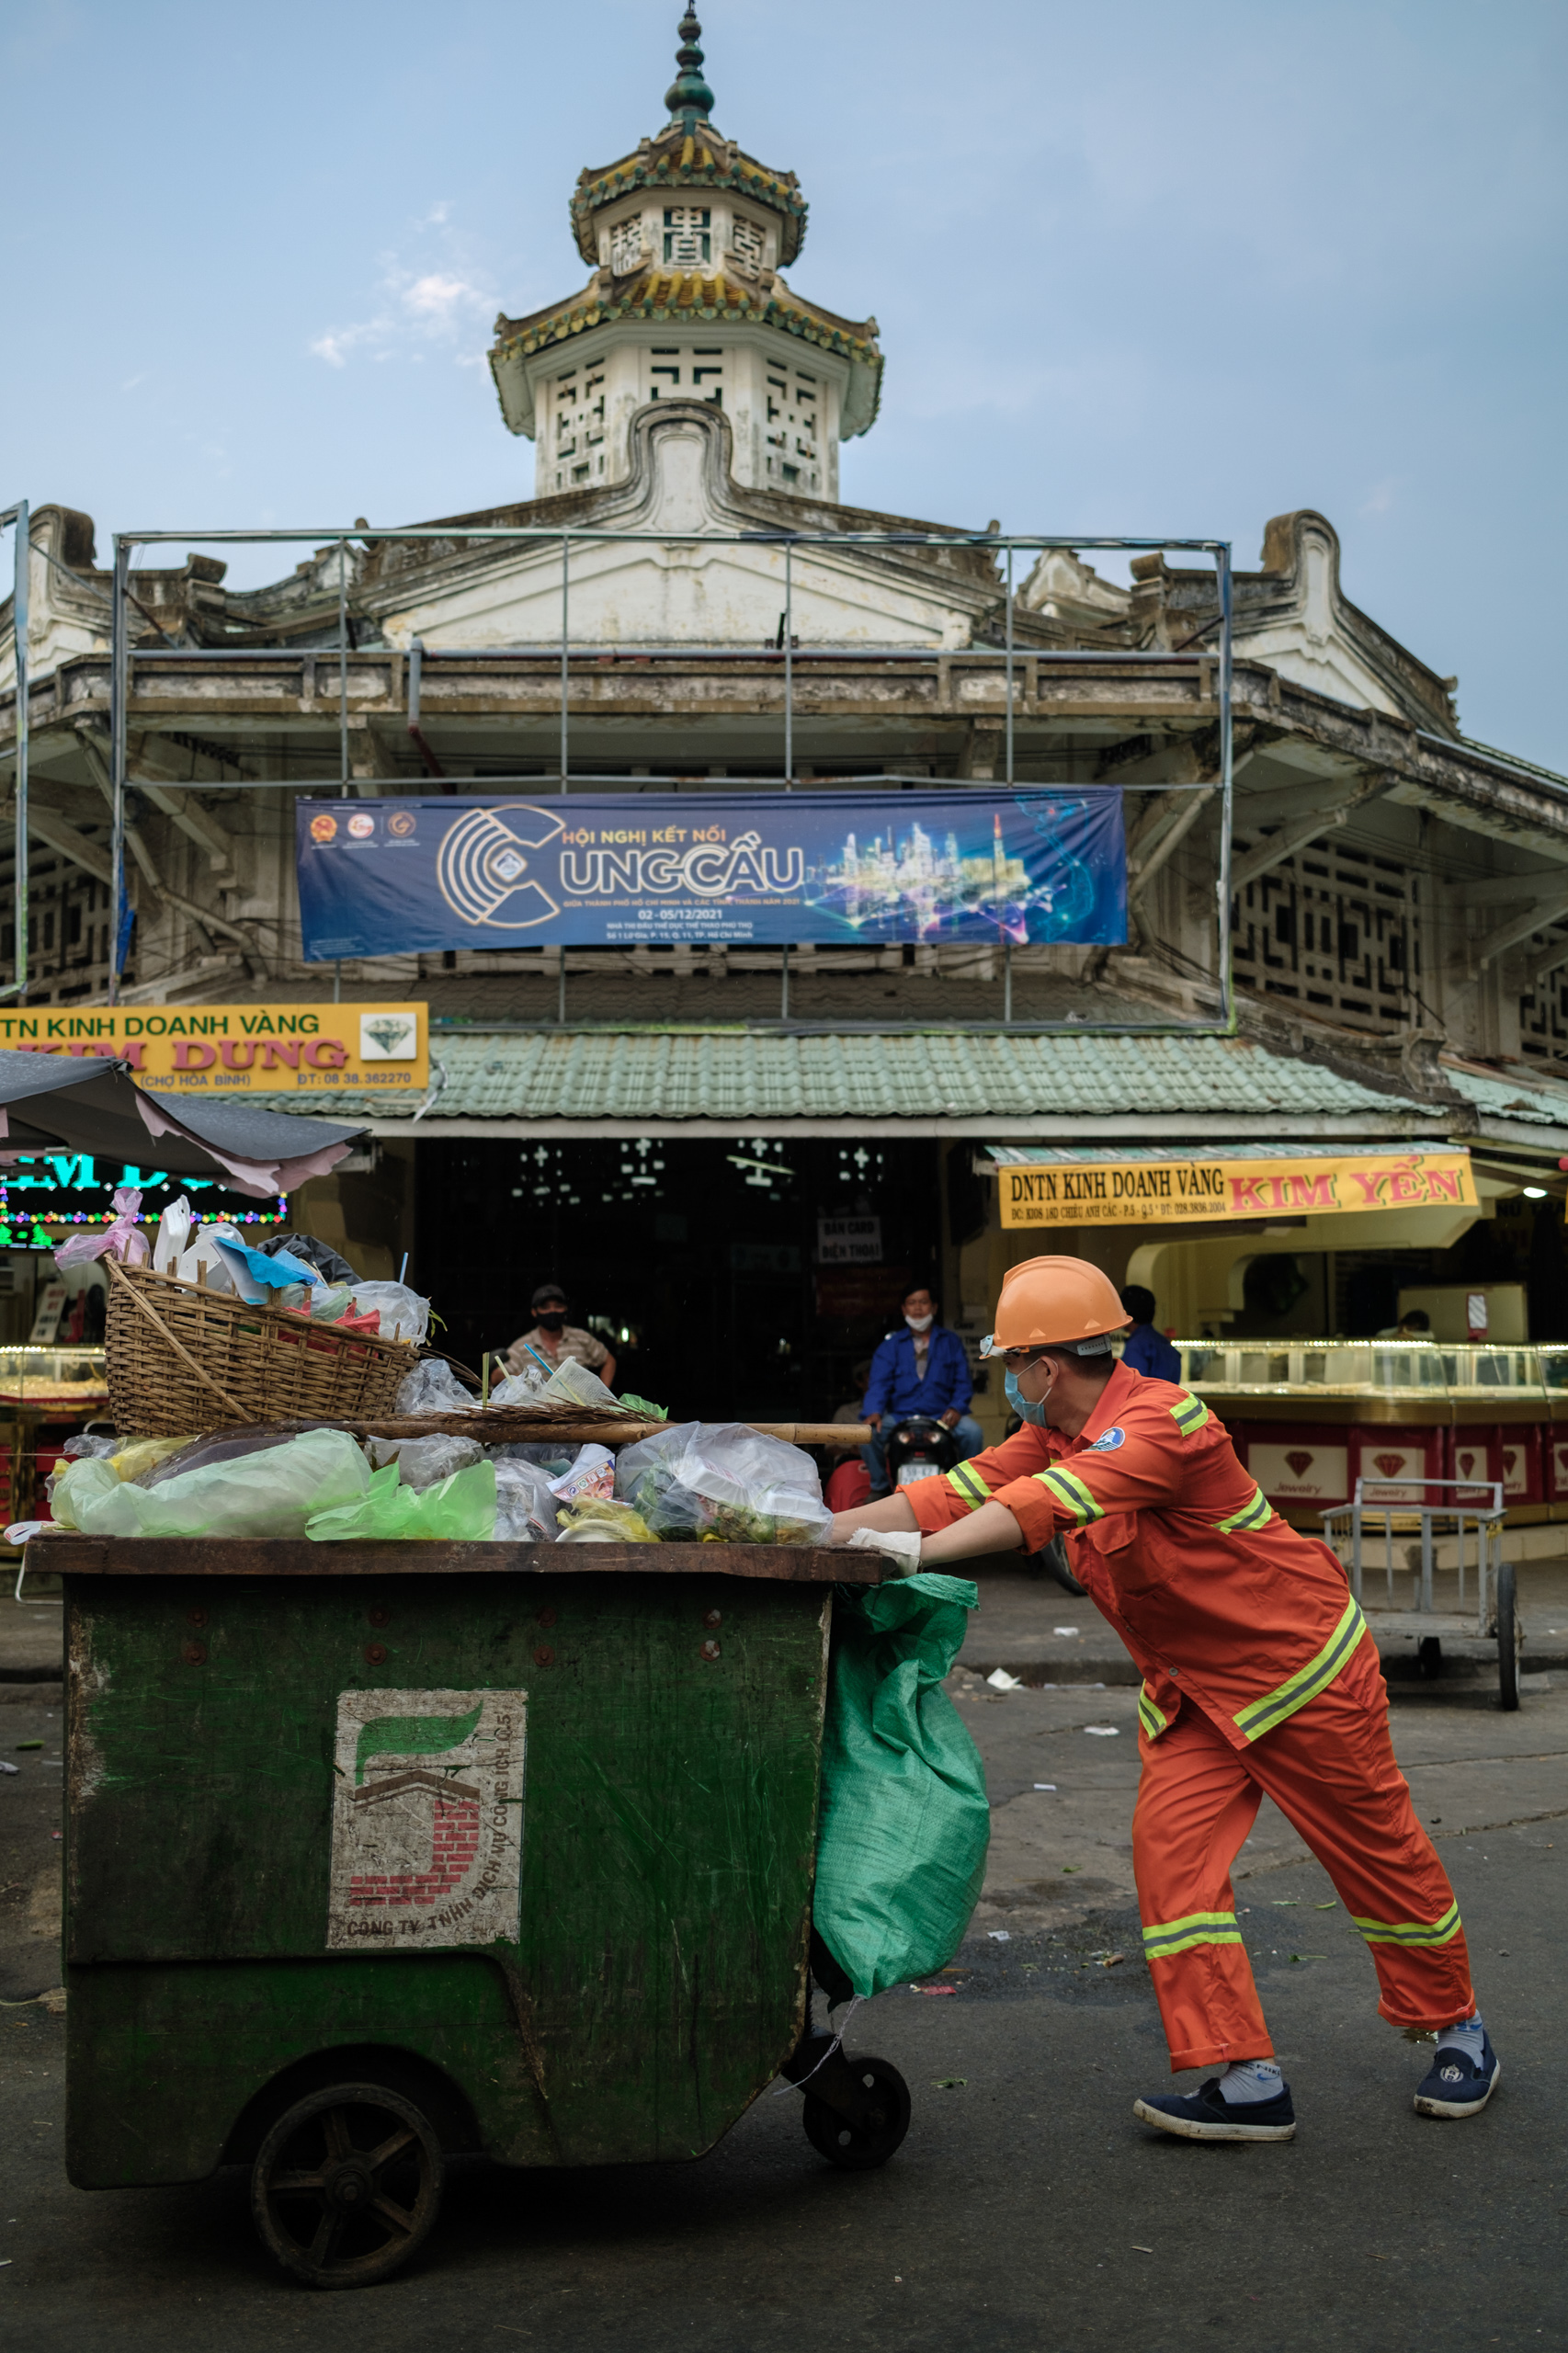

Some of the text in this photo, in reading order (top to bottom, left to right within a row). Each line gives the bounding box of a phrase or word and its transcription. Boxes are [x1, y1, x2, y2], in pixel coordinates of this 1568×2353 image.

[562, 824, 726, 847] HỘI NGHỊ KẾT NỐI
[733, 930, 753, 938] Minh
[48, 1017, 115, 1037] KINH
[125, 1016, 228, 1036] DOANH
[239, 1009, 319, 1034] VÀNG
[172, 1039, 349, 1071] DUNG
[141, 1074, 175, 1089] (CHỢ
[215, 1071, 250, 1086] BÌNH)
[324, 1074, 339, 1085] 08
[344, 1073, 411, 1085] 38.362270
[1011, 1162, 1224, 1201] DNTN KINH DOANH VÀNG
[1228, 1174, 1338, 1213] KIM
[1085, 1205, 1100, 1218] ANH
[1274, 1482, 1322, 1495] Jewelry
[1369, 1486, 1408, 1497] Jewelry
[490, 1779, 510, 1827] CÔNG
[491, 1832, 509, 1854] VỤ
[427, 1897, 474, 1930] TNHH
[347, 1917, 393, 1937] CÔNG
[398, 1919, 421, 1935] TY
